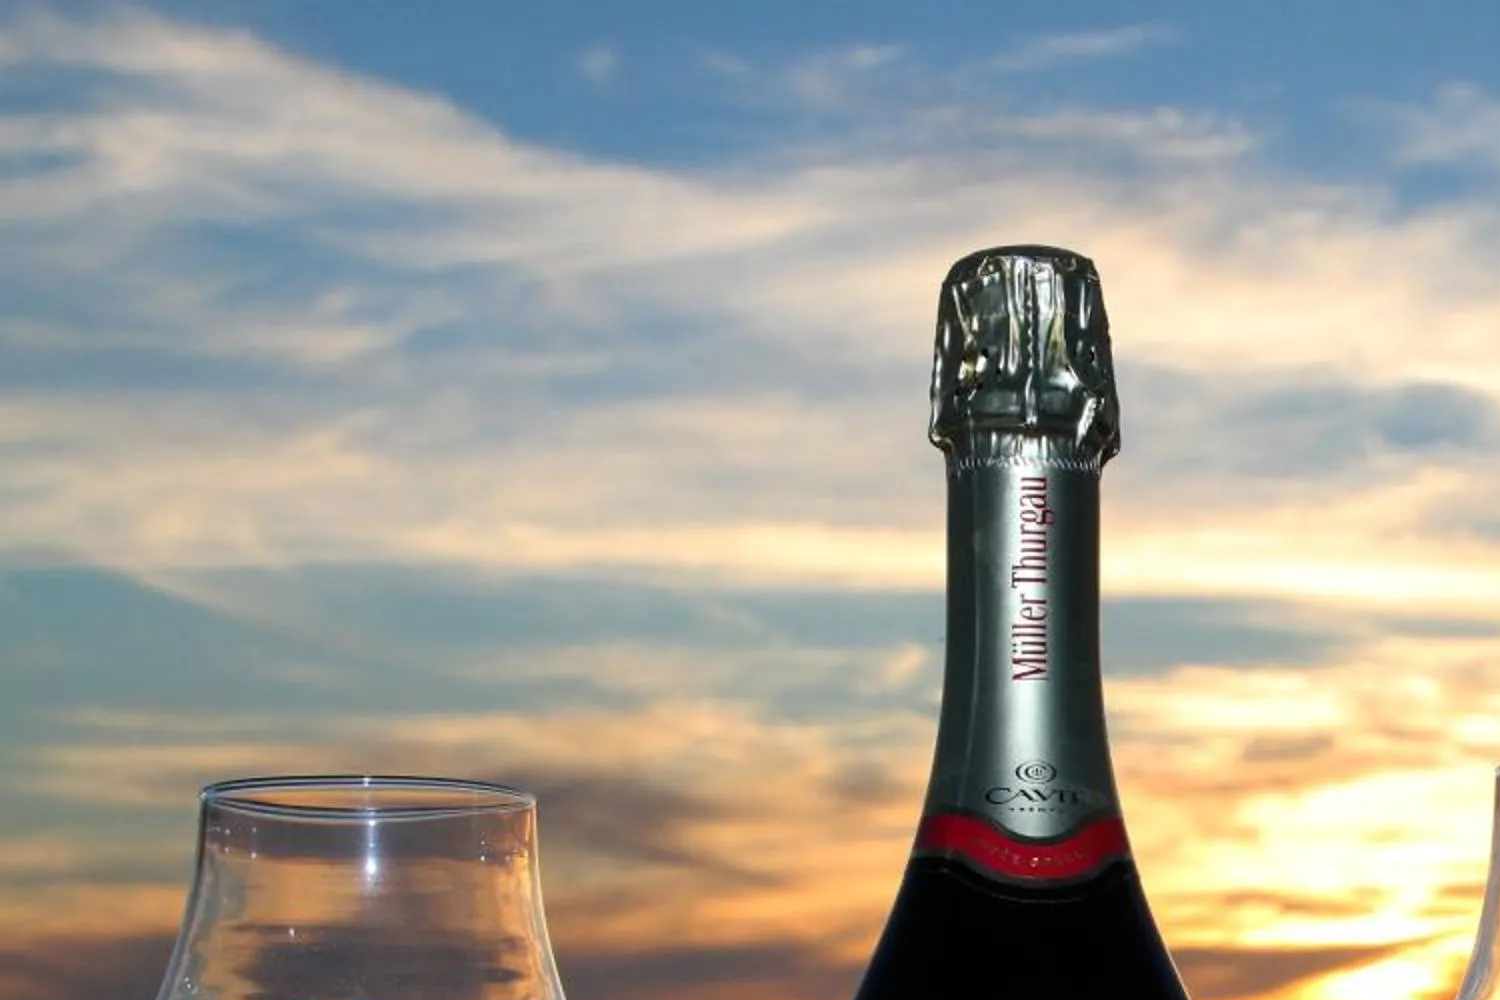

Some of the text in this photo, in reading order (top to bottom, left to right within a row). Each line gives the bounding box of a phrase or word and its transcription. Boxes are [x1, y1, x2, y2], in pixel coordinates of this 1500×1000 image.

[1011, 476, 1055, 681] Müller Thurgau
[985, 787, 1085, 804] CAVIT
